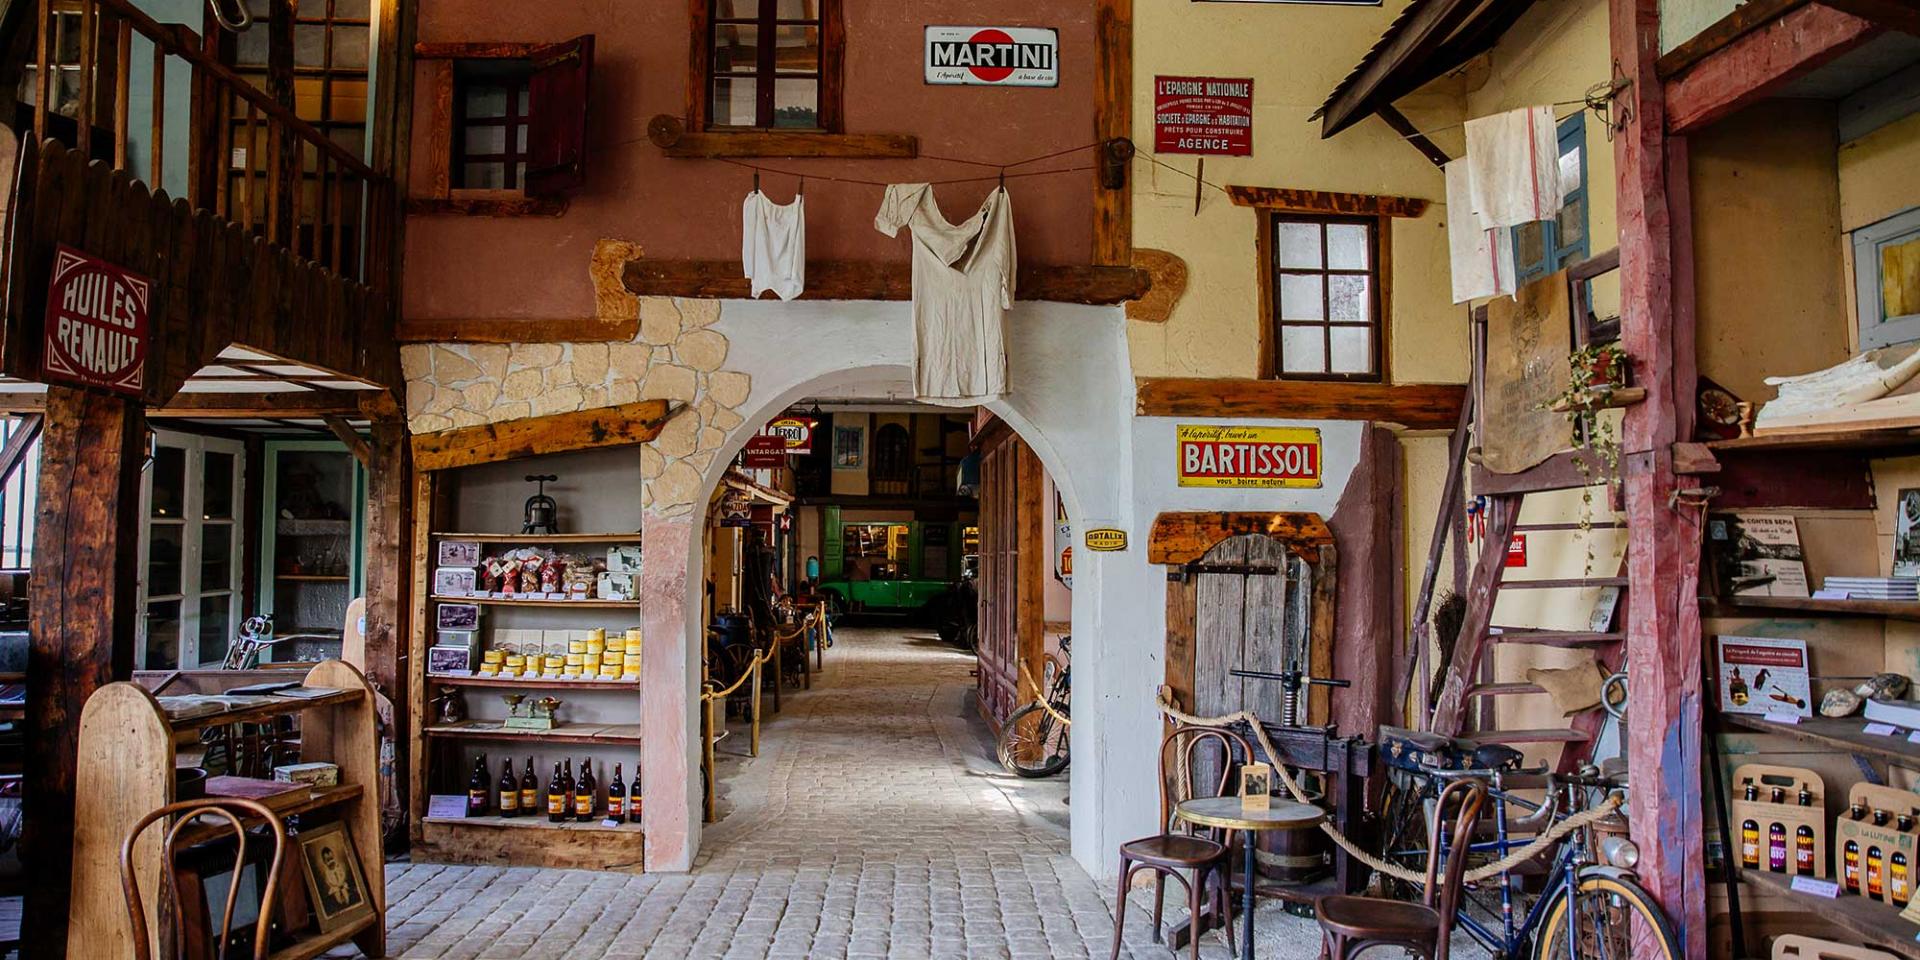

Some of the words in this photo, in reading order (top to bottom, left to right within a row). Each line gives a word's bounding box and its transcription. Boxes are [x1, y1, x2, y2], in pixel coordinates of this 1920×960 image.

[934, 43, 1049, 68] MARTINI
[1159, 81, 1203, 96] L'EPARGNE
[1206, 82, 1249, 97] NATIONALE
[1205, 127, 1243, 135] CONSTRUIRE
[1178, 138, 1229, 150] AGENCE
[63, 272, 137, 329] HUILES
[57, 316, 139, 374] RENAULT
[1185, 443, 1314, 475] BARTISSOL
[1261, 478, 1286, 486] naturel
[1088, 532, 1123, 540] OPTALIX
[1770, 847, 1786, 859] BIO
